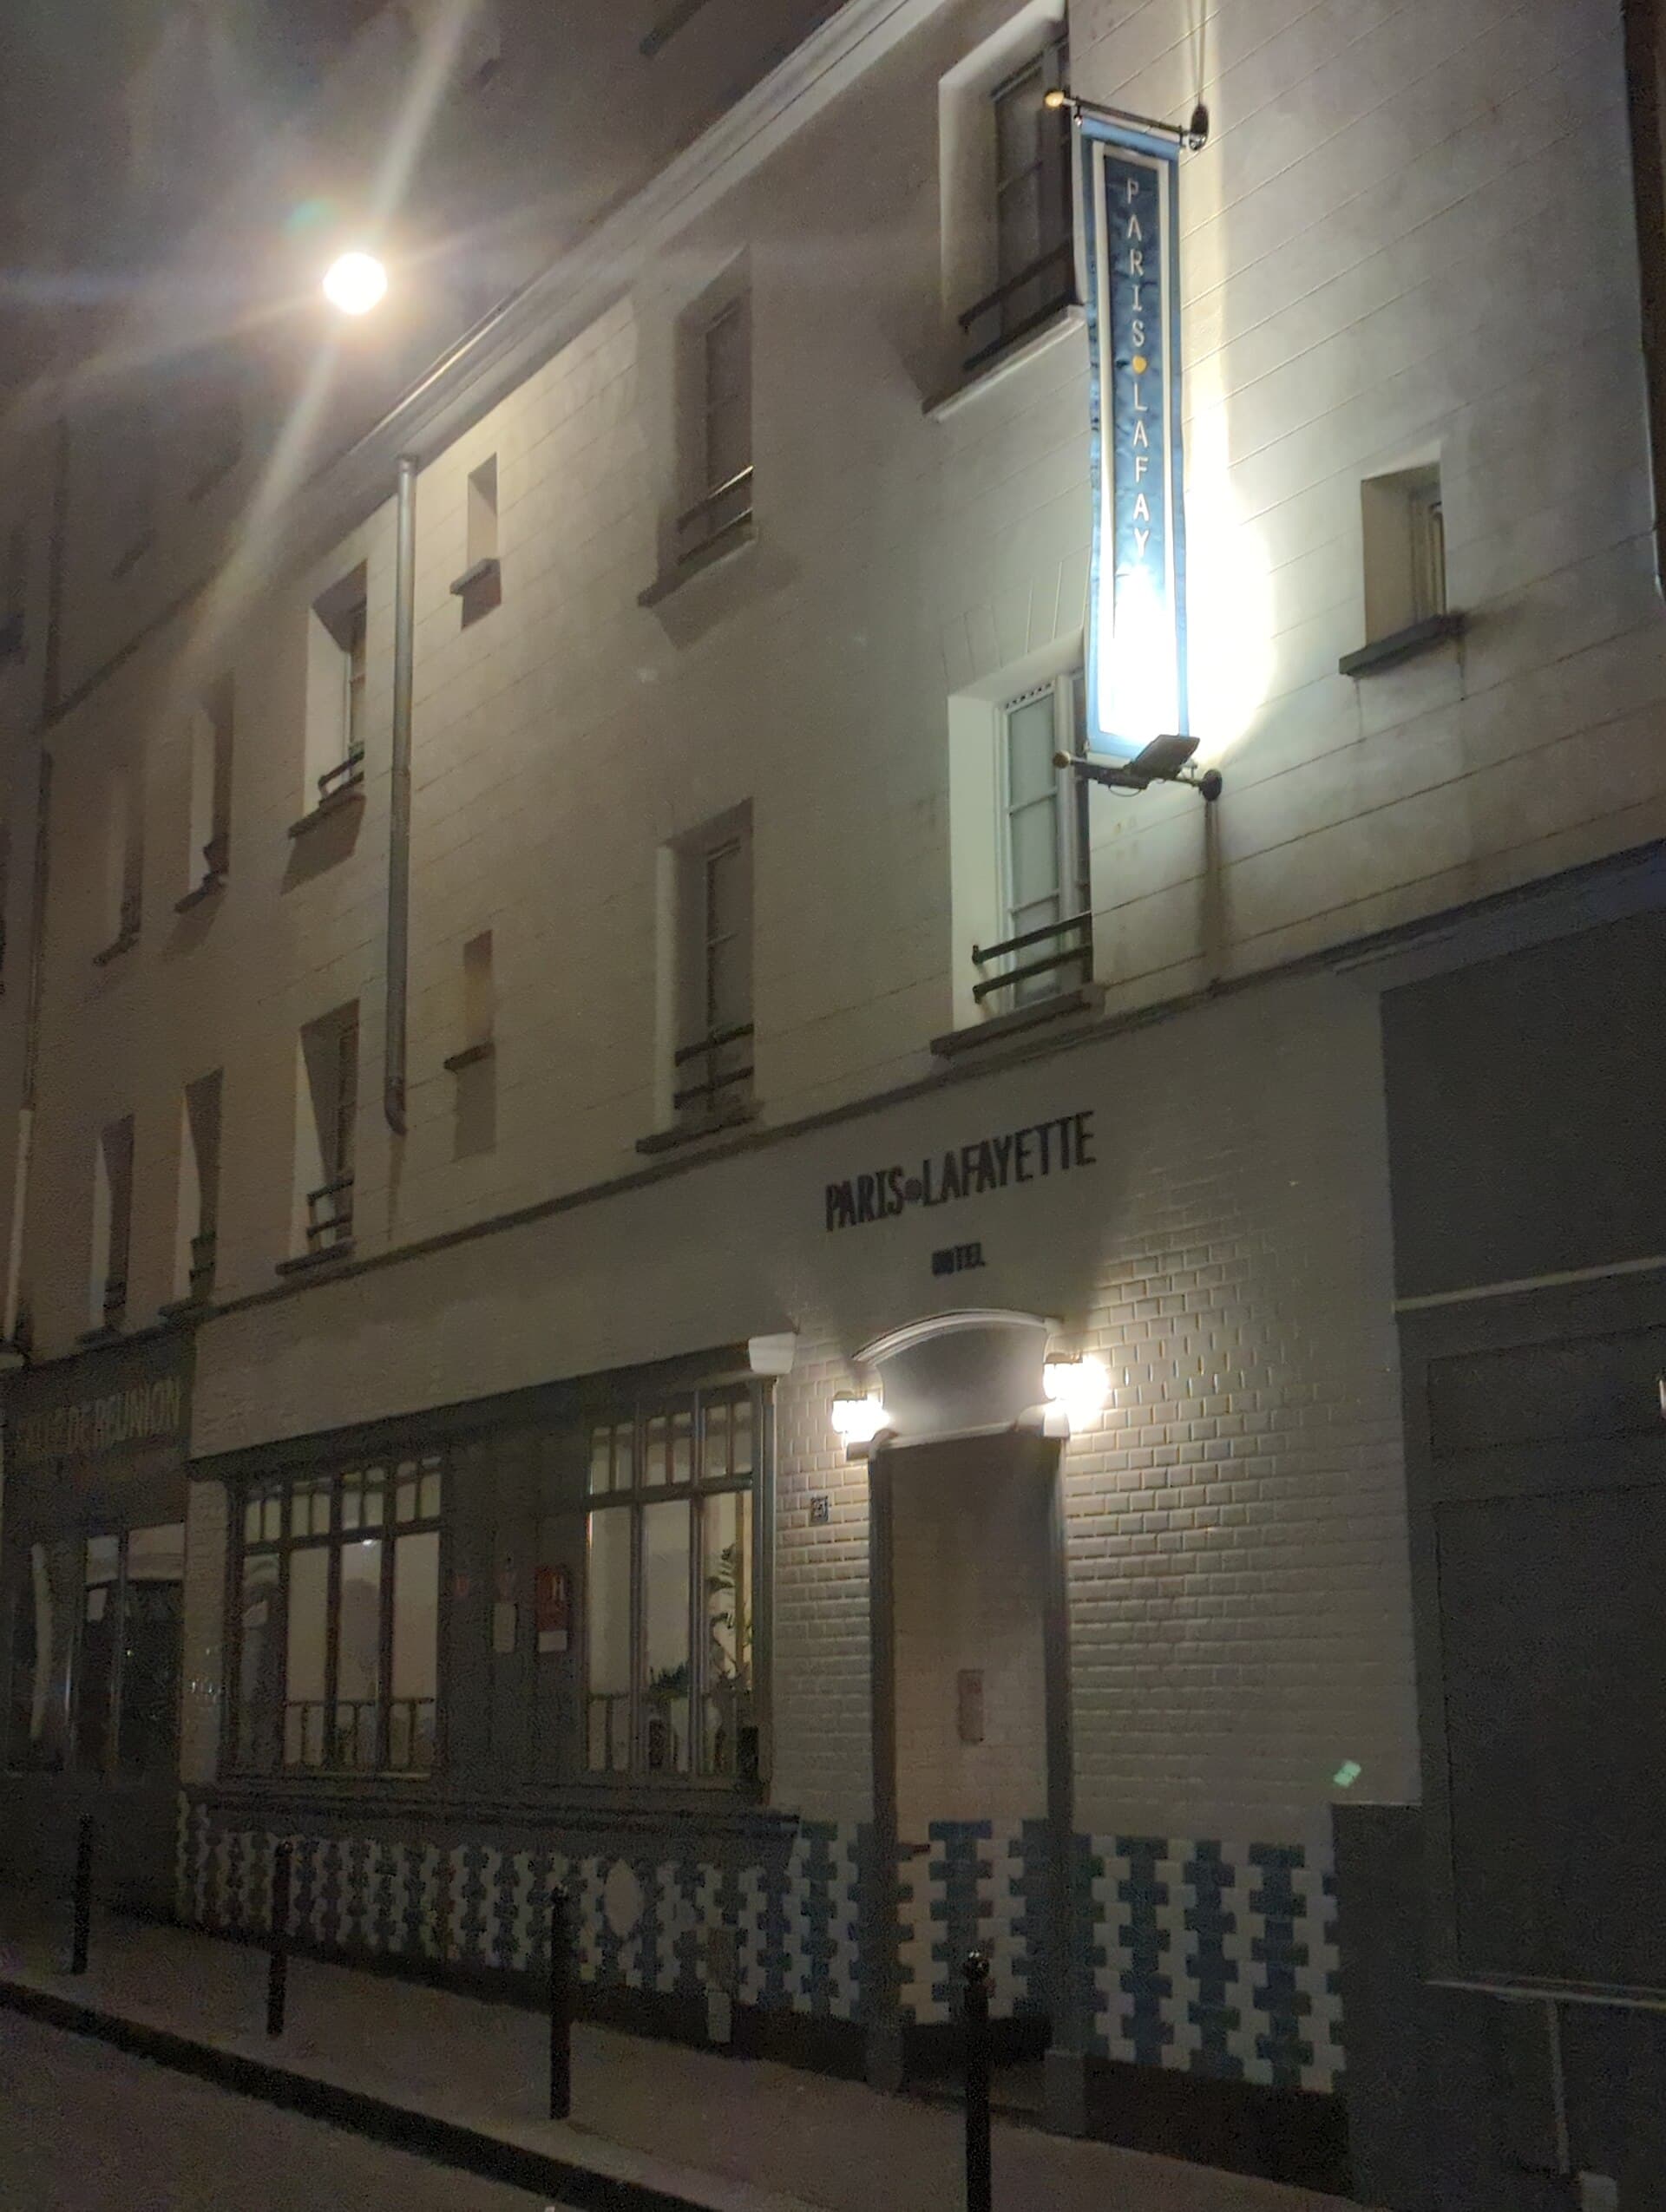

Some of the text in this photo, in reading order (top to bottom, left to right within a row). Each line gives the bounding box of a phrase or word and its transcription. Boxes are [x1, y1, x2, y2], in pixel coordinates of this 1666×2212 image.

[1125, 178, 1147, 349] PARIS
[826, 1110, 1097, 1232] PARIS LAFAYETTE
